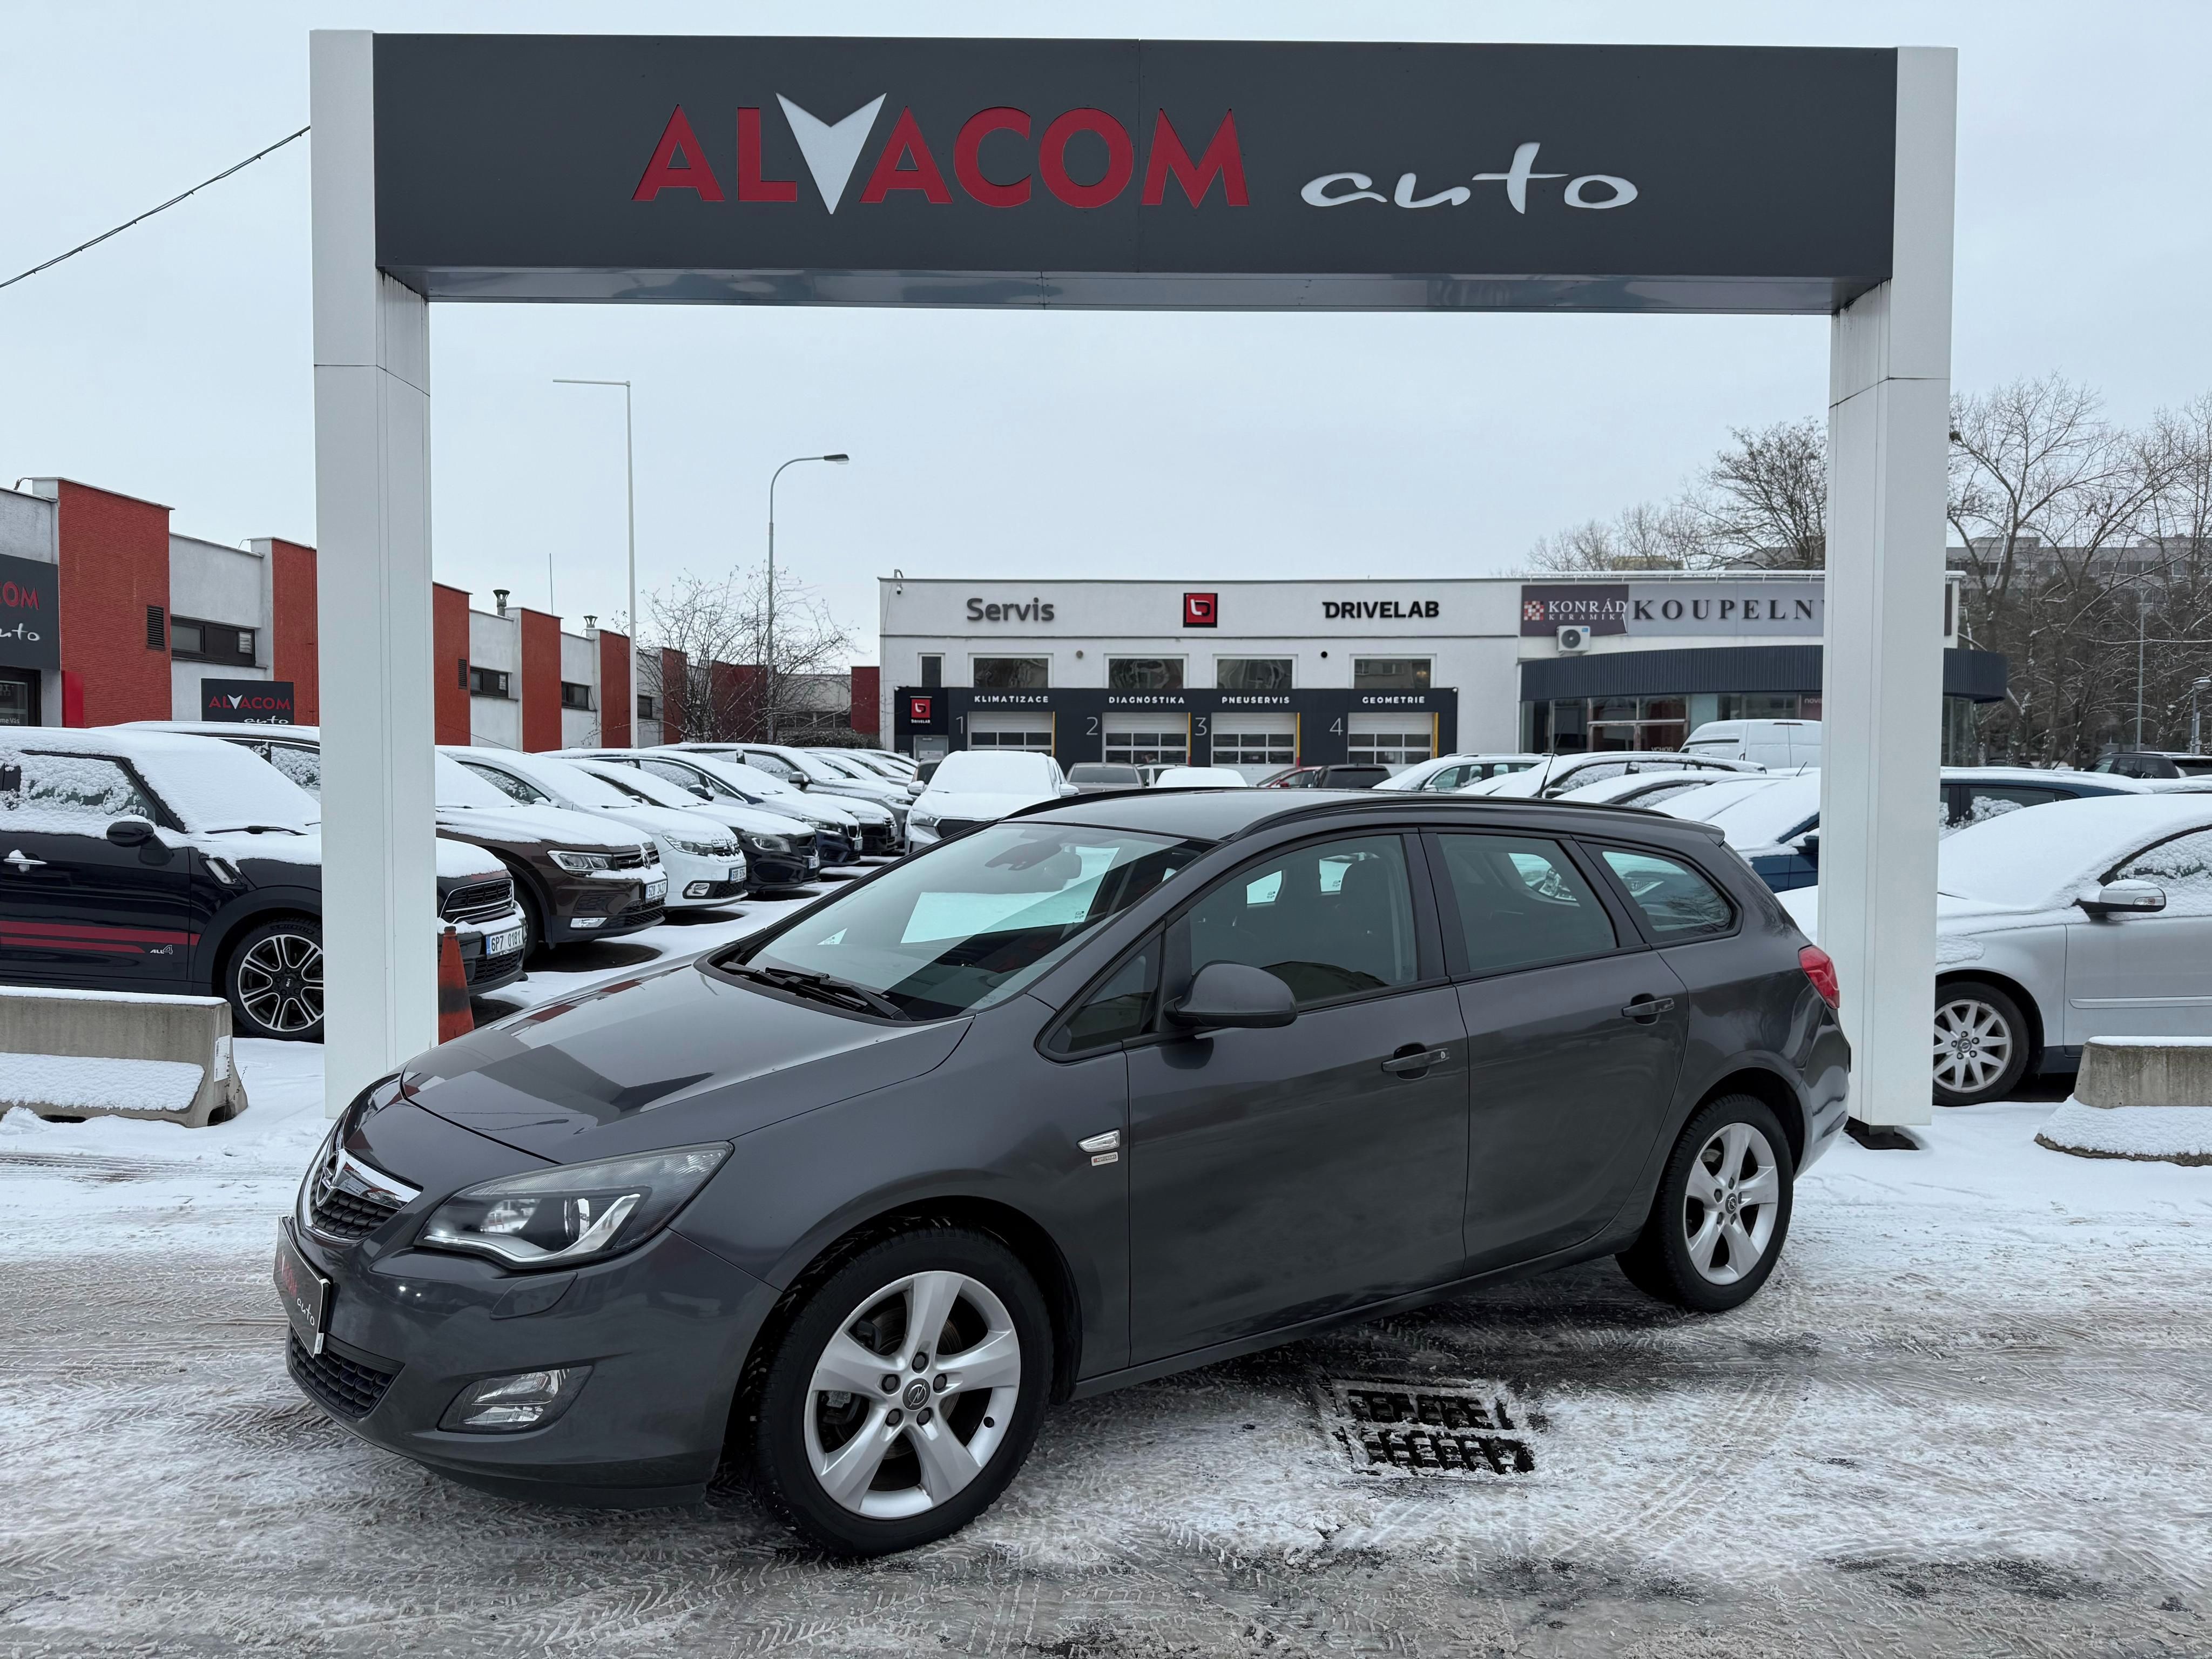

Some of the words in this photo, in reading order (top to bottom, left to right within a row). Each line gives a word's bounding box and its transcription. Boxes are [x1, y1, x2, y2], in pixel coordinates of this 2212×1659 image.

[631, 92, 1250, 215] ALVACOM
[1300, 141, 1638, 214] auto
[0, 581, 39, 610] OM
[966, 597, 1055, 621] Servis
[1322, 601, 1440, 619] DRIVELAB
[1548, 598, 1626, 613] KONRÁD
[1633, 599, 1824, 620] KOUPELN
[0, 623, 41, 641] uto
[208, 694, 292, 710] ALVACOM
[1108, 696, 1185, 704] DIAGNOSTIKA
[1222, 696, 1290, 704] PNEUSERVIS
[1362, 696, 1426, 704] GEOMETRIE
[244, 716, 289, 725] auto
[956, 716, 963, 734] 1
[1086, 717, 1098, 736] 2
[1195, 717, 1207, 736] 3
[1329, 717, 1344, 736] 4
[150, 945, 173, 955] ALL4
[491, 935, 504, 952] 6P7
[508, 930, 521, 947] 0181
[297, 1298, 315, 1326] auto
